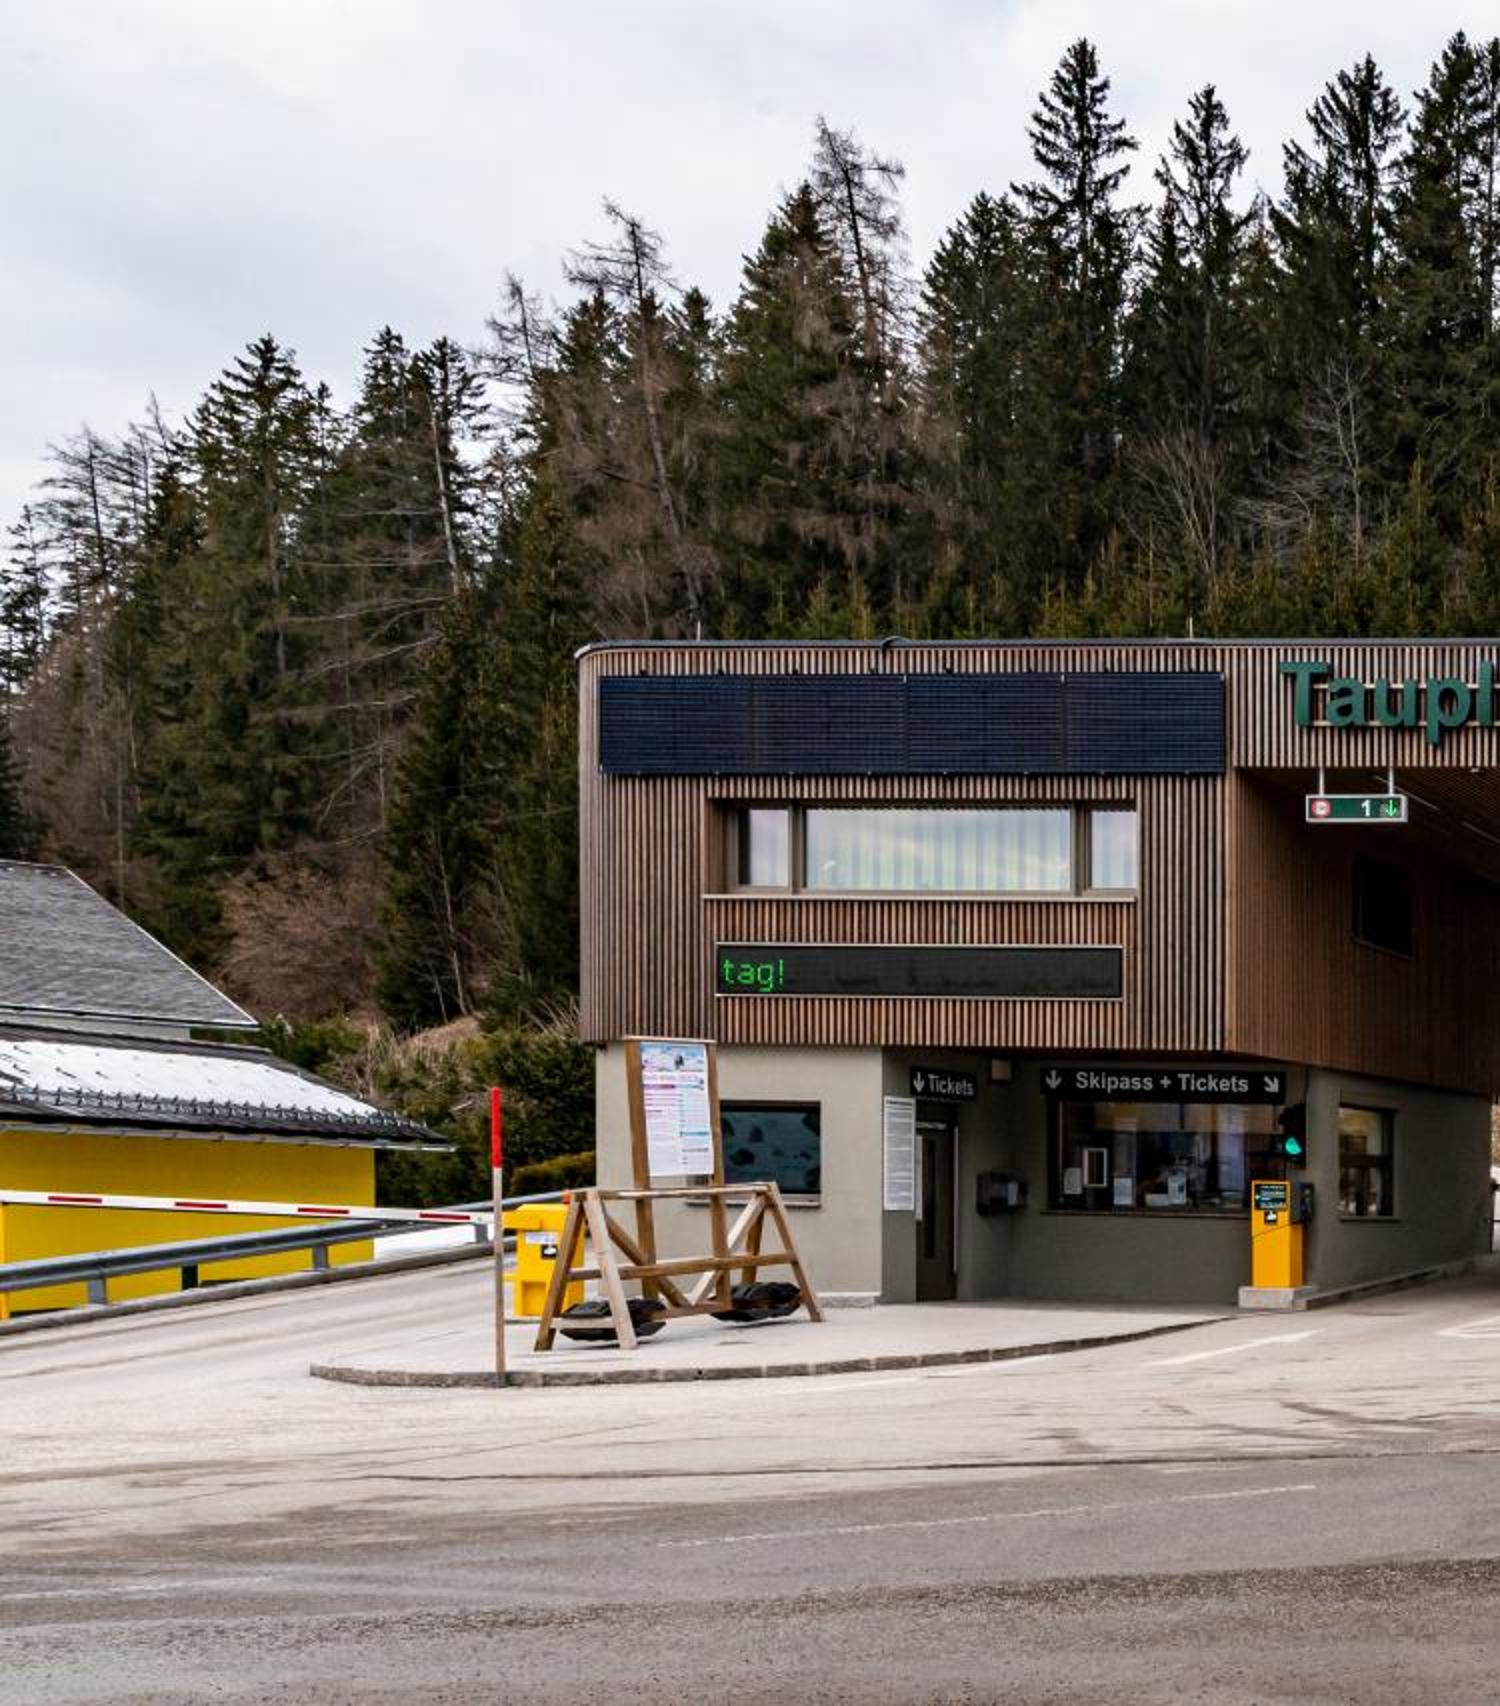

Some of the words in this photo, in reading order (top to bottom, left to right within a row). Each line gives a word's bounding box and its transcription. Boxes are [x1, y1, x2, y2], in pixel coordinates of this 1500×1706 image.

[1361, 799, 1371, 817] 1
[723, 959, 784, 993] tag!
[927, 1074, 975, 1097] Tickets
[1075, 1071, 1153, 1094] Skipass
[1177, 1073, 1249, 1093] Tickets
